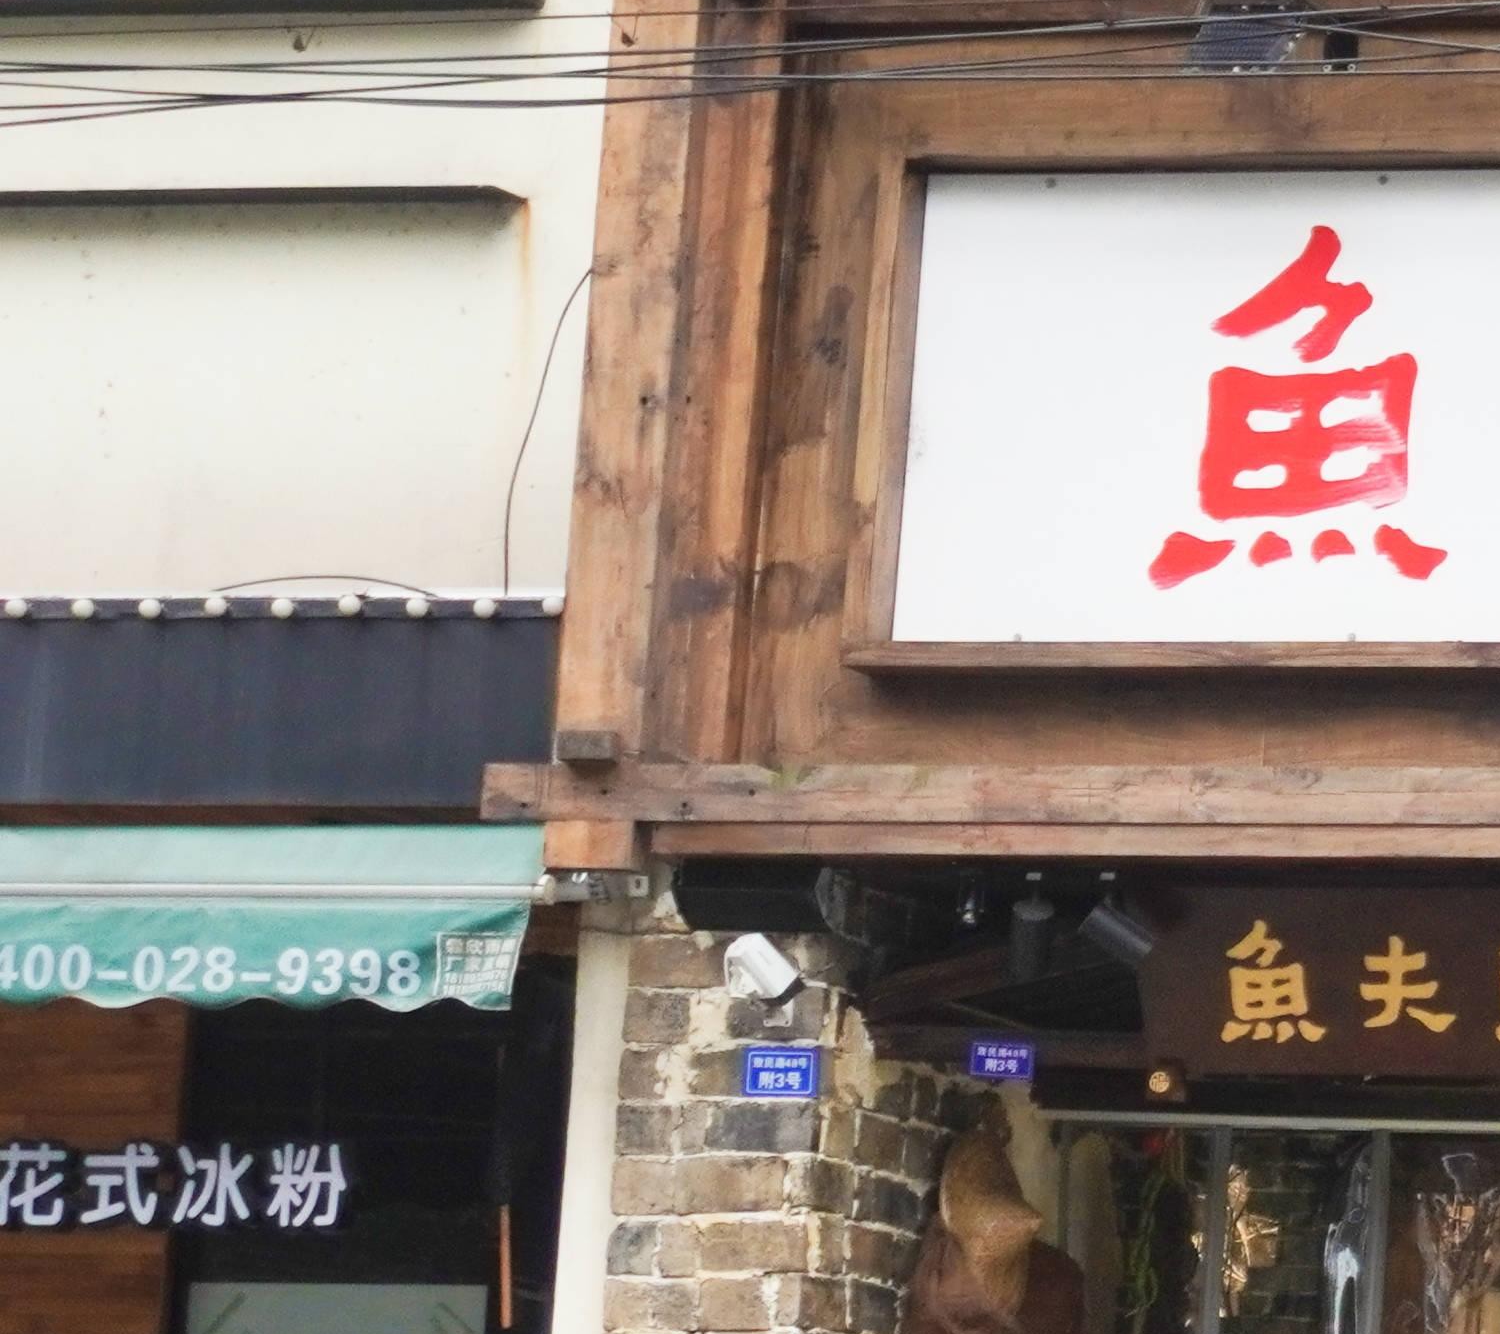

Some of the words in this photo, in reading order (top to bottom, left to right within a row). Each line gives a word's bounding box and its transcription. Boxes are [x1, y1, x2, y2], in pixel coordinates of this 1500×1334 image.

[0, 944, 421, 997] 400-028-9398
[758, 1071, 802, 1090] 附3号
[0, 1142, 347, 1227] 花式冰粉
